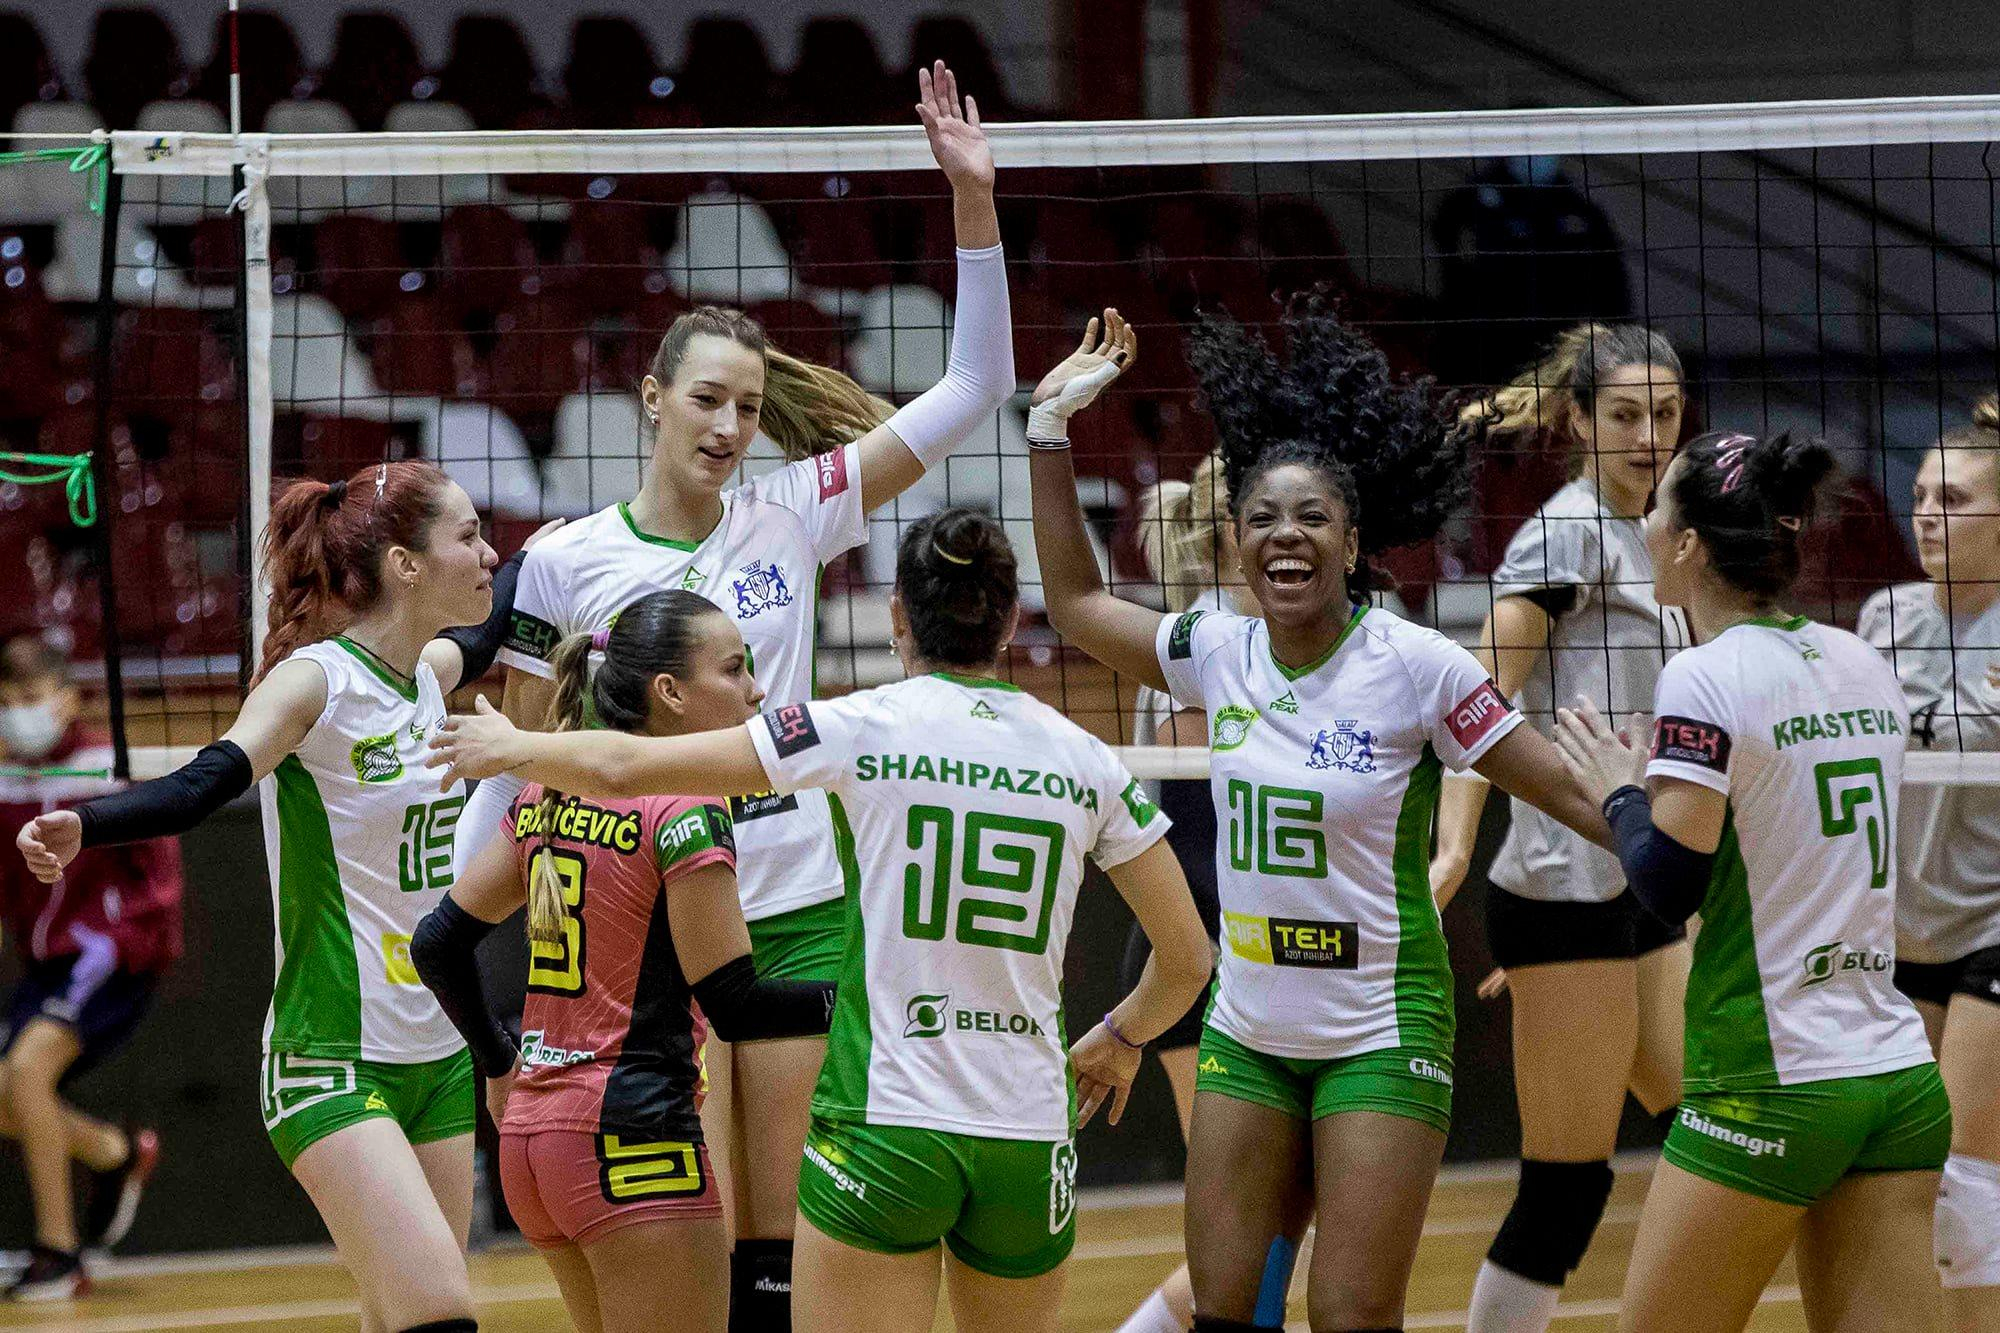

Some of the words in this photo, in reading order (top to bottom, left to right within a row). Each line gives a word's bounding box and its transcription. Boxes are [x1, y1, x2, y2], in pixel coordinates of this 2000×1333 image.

[780, 704, 809, 742] EK
[1269, 702, 1299, 714] PEAK
[1457, 691, 1500, 729] AIR
[1663, 723, 1720, 760] TEK
[1773, 708, 1901, 750] KRASTEVA
[856, 754, 1099, 815] SHAHPAZOVA
[515, 799, 639, 852] BOIČEVIĆ
[1227, 777, 1329, 880] 16
[902, 804, 1067, 956] 19
[1275, 925, 1342, 957] TEK
[1680, 1107, 1786, 1157] Chimagri
[754, 1276, 792, 1293] MIKAS
